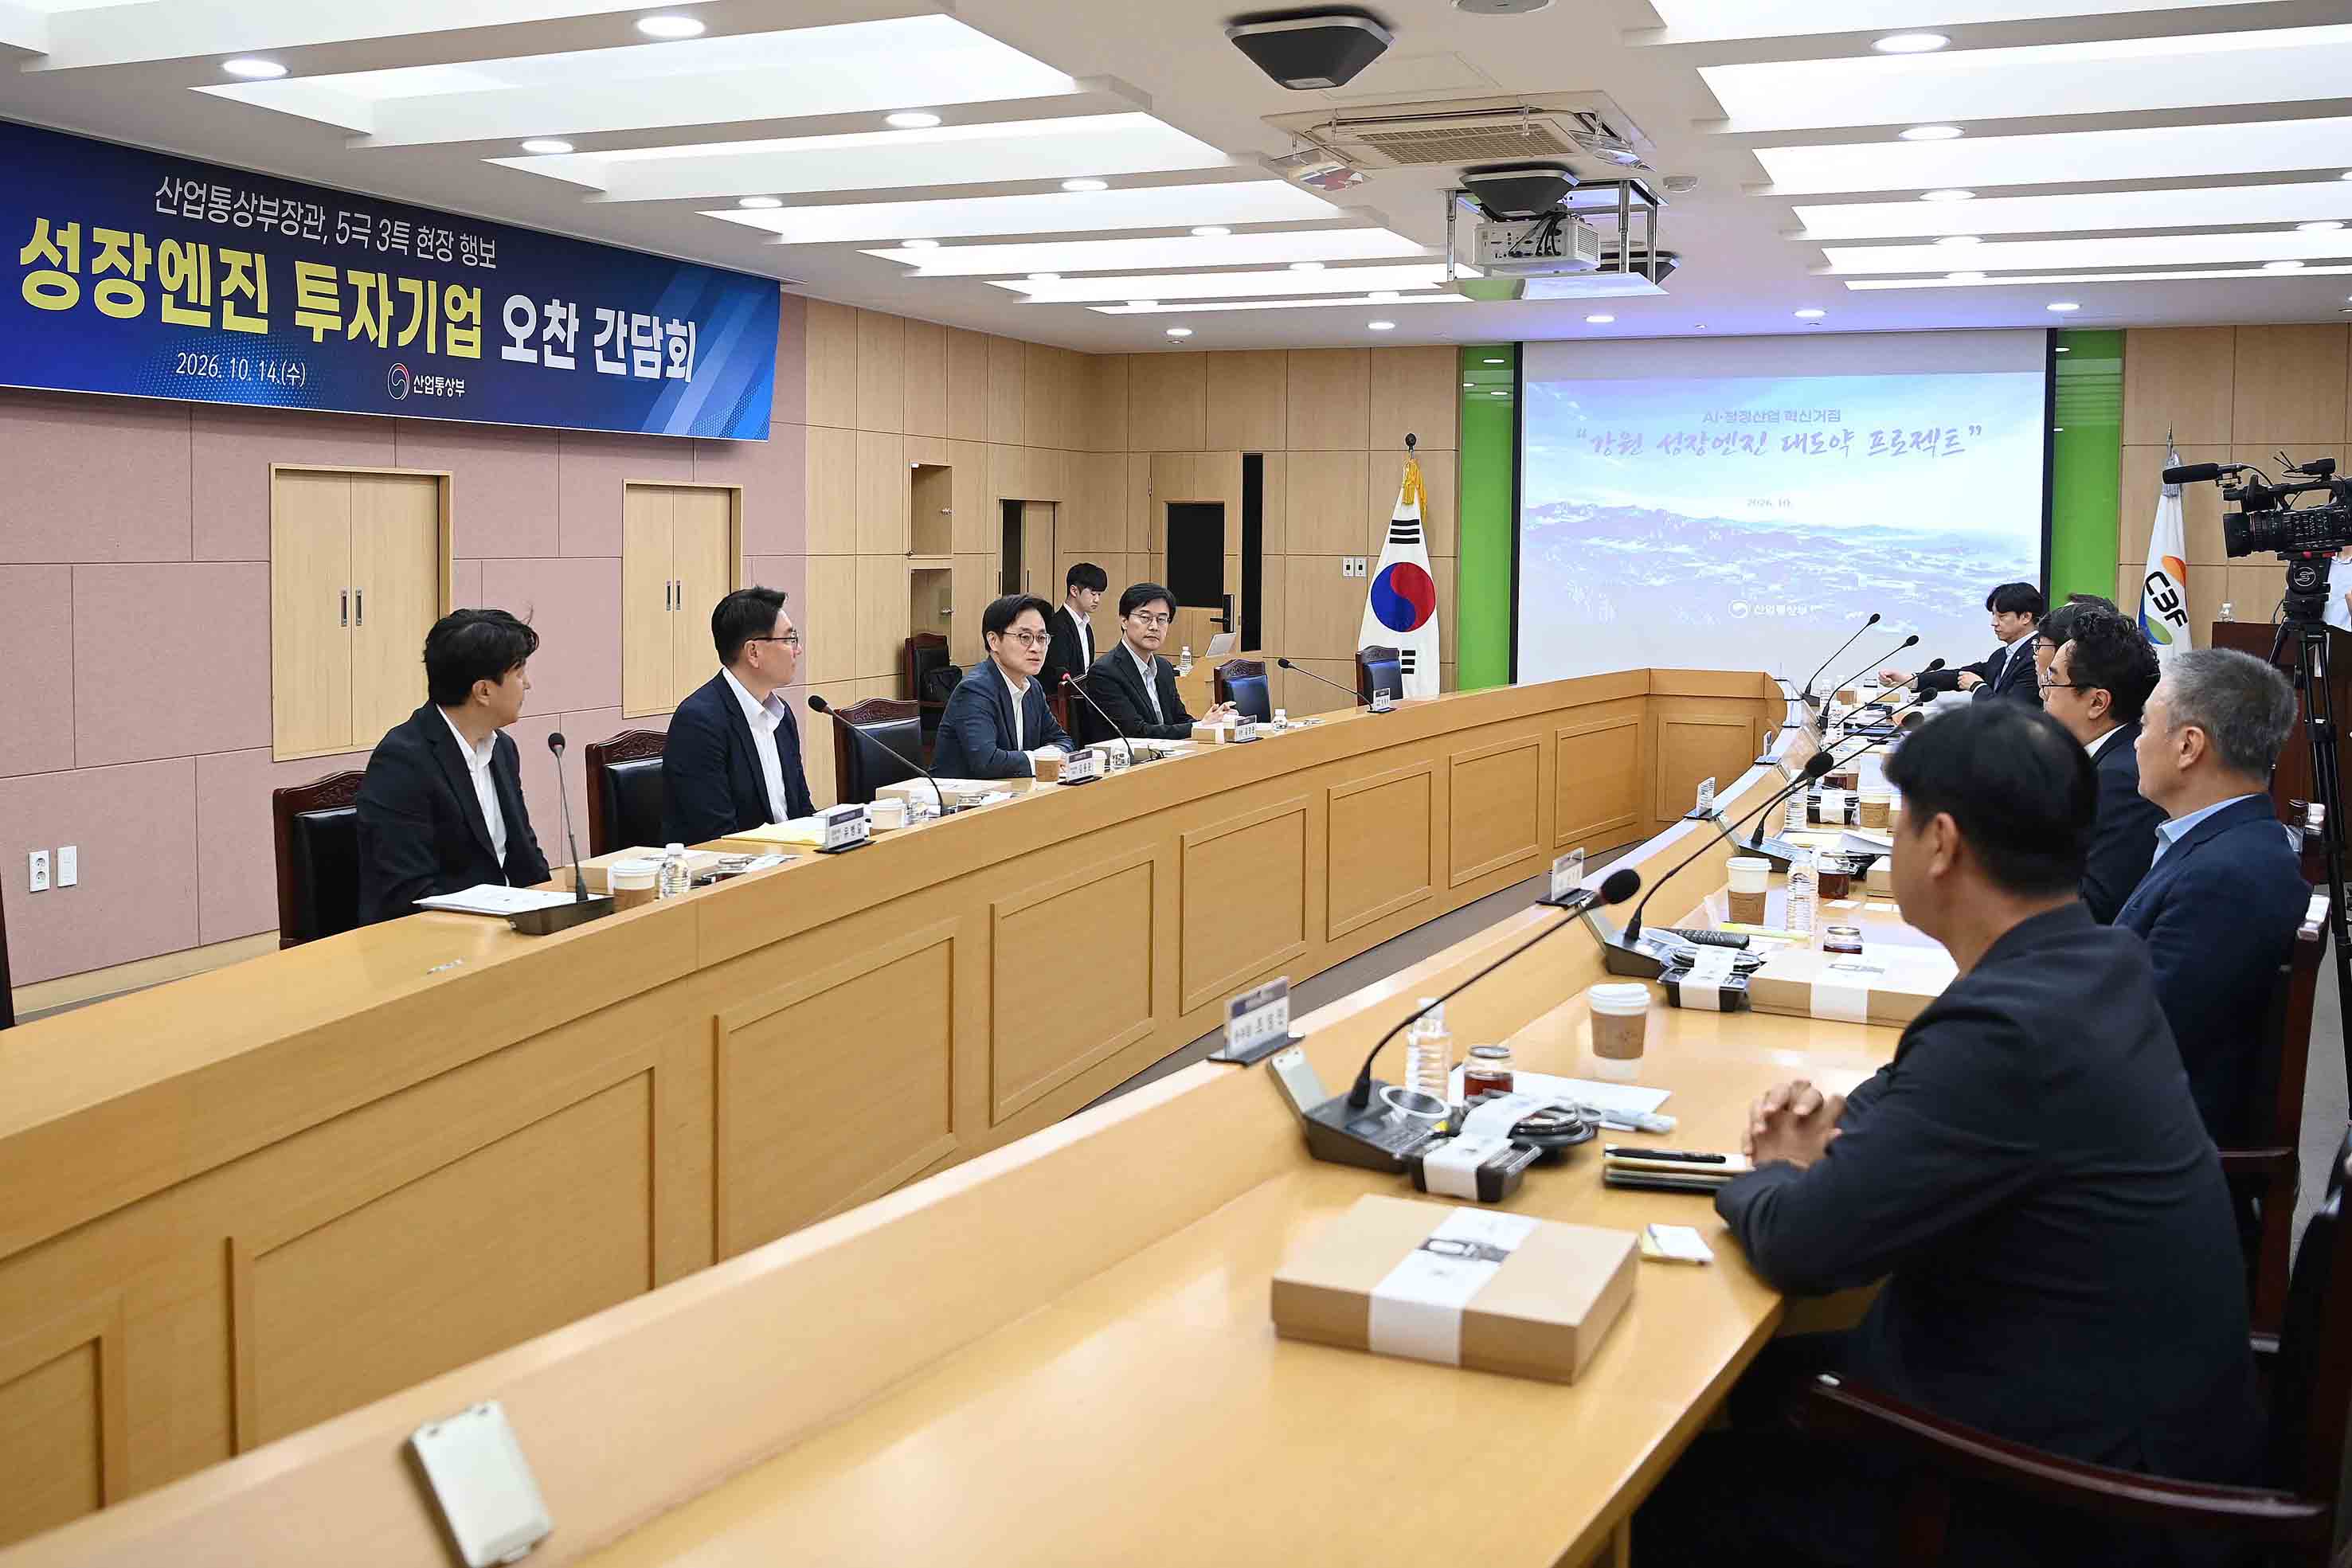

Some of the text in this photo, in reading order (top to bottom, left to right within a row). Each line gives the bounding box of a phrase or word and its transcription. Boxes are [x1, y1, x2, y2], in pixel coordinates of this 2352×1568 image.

[155, 176, 497, 269] 산업통상부장관, 5극 3특 현장 행보
[20, 217, 698, 383] 성장엔진 투자기업 오찬 간담회
[175, 352, 222, 379] 2026.
[229, 358, 252, 381] 10.
[413, 374, 466, 398] 산업통상부
[1656, 429, 1770, 457] 성장엔진
[1781, 428, 1855, 459] 대도약
